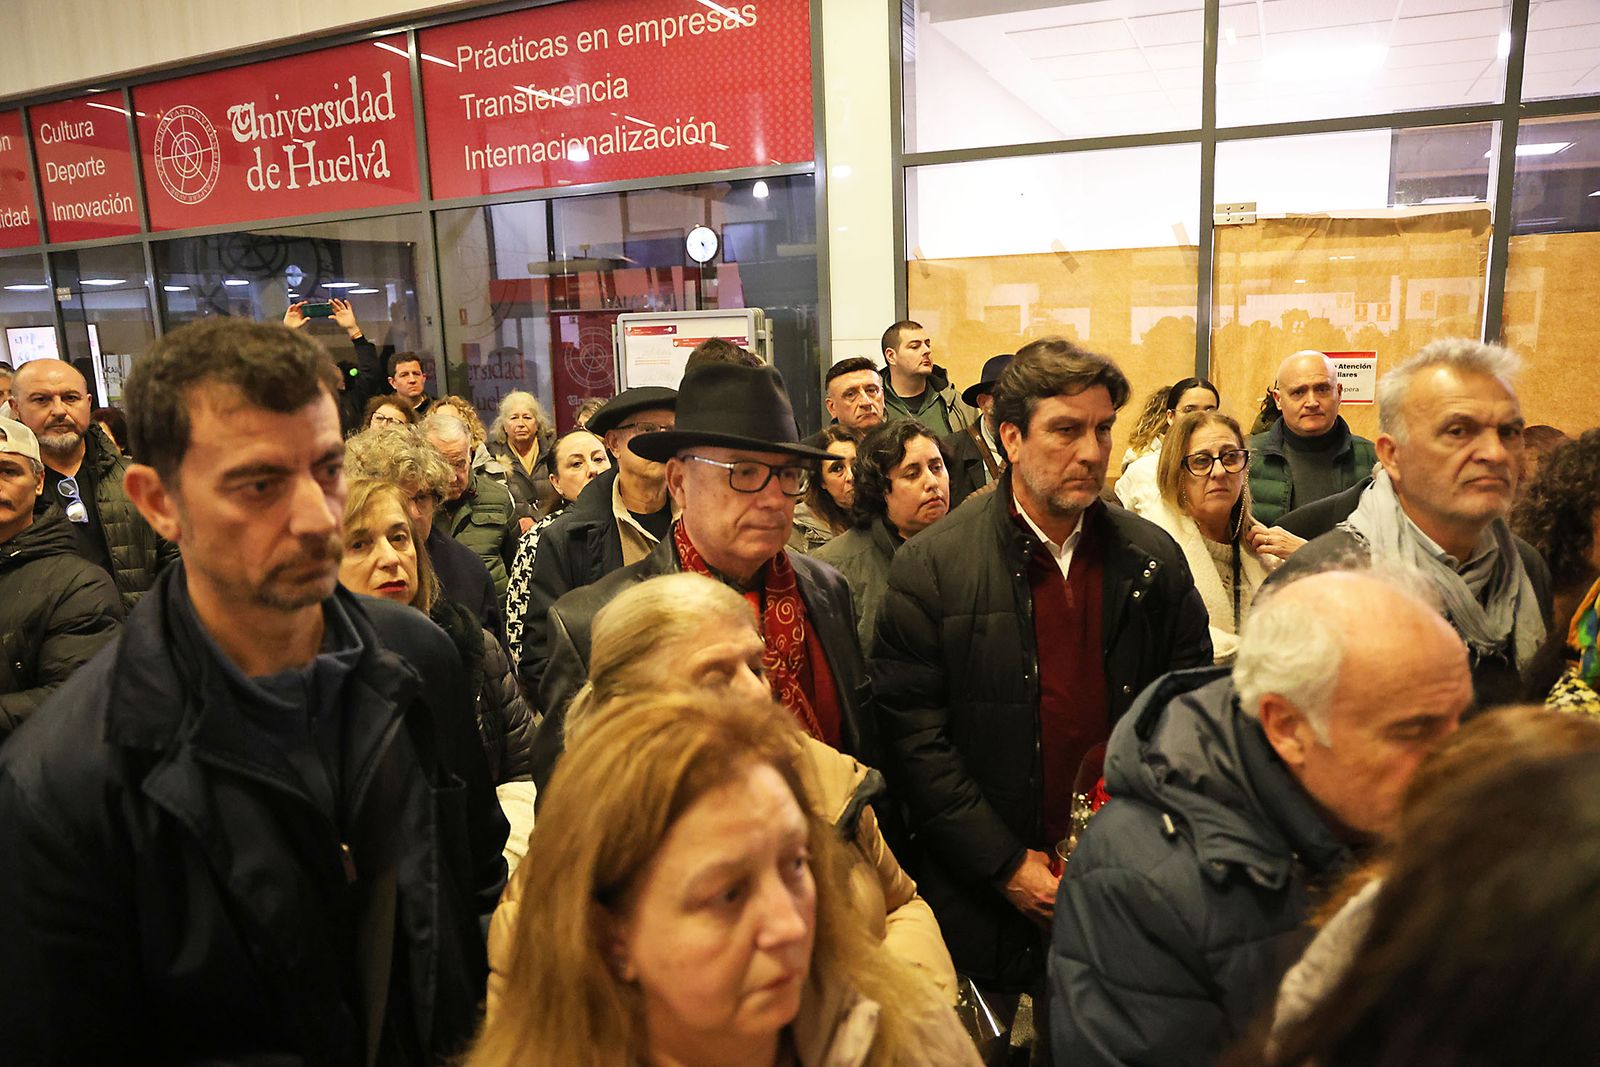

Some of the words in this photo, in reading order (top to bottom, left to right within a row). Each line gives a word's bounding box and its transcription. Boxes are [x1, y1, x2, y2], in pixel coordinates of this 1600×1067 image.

[456, 35, 568, 73] Prácticas
[577, 27, 609, 53] en
[618, 3, 758, 48] empresas
[226, 70, 396, 143] Universidad
[459, 73, 629, 120] Transferencia
[40, 120, 95, 145] Cultura
[464, 116, 717, 171] Internacionalización
[46, 156, 106, 185] Deporte
[246, 146, 281, 192] de
[281, 135, 391, 190] Huelva
[0, 205, 30, 229] idad
[52, 192, 134, 221] Innovación
